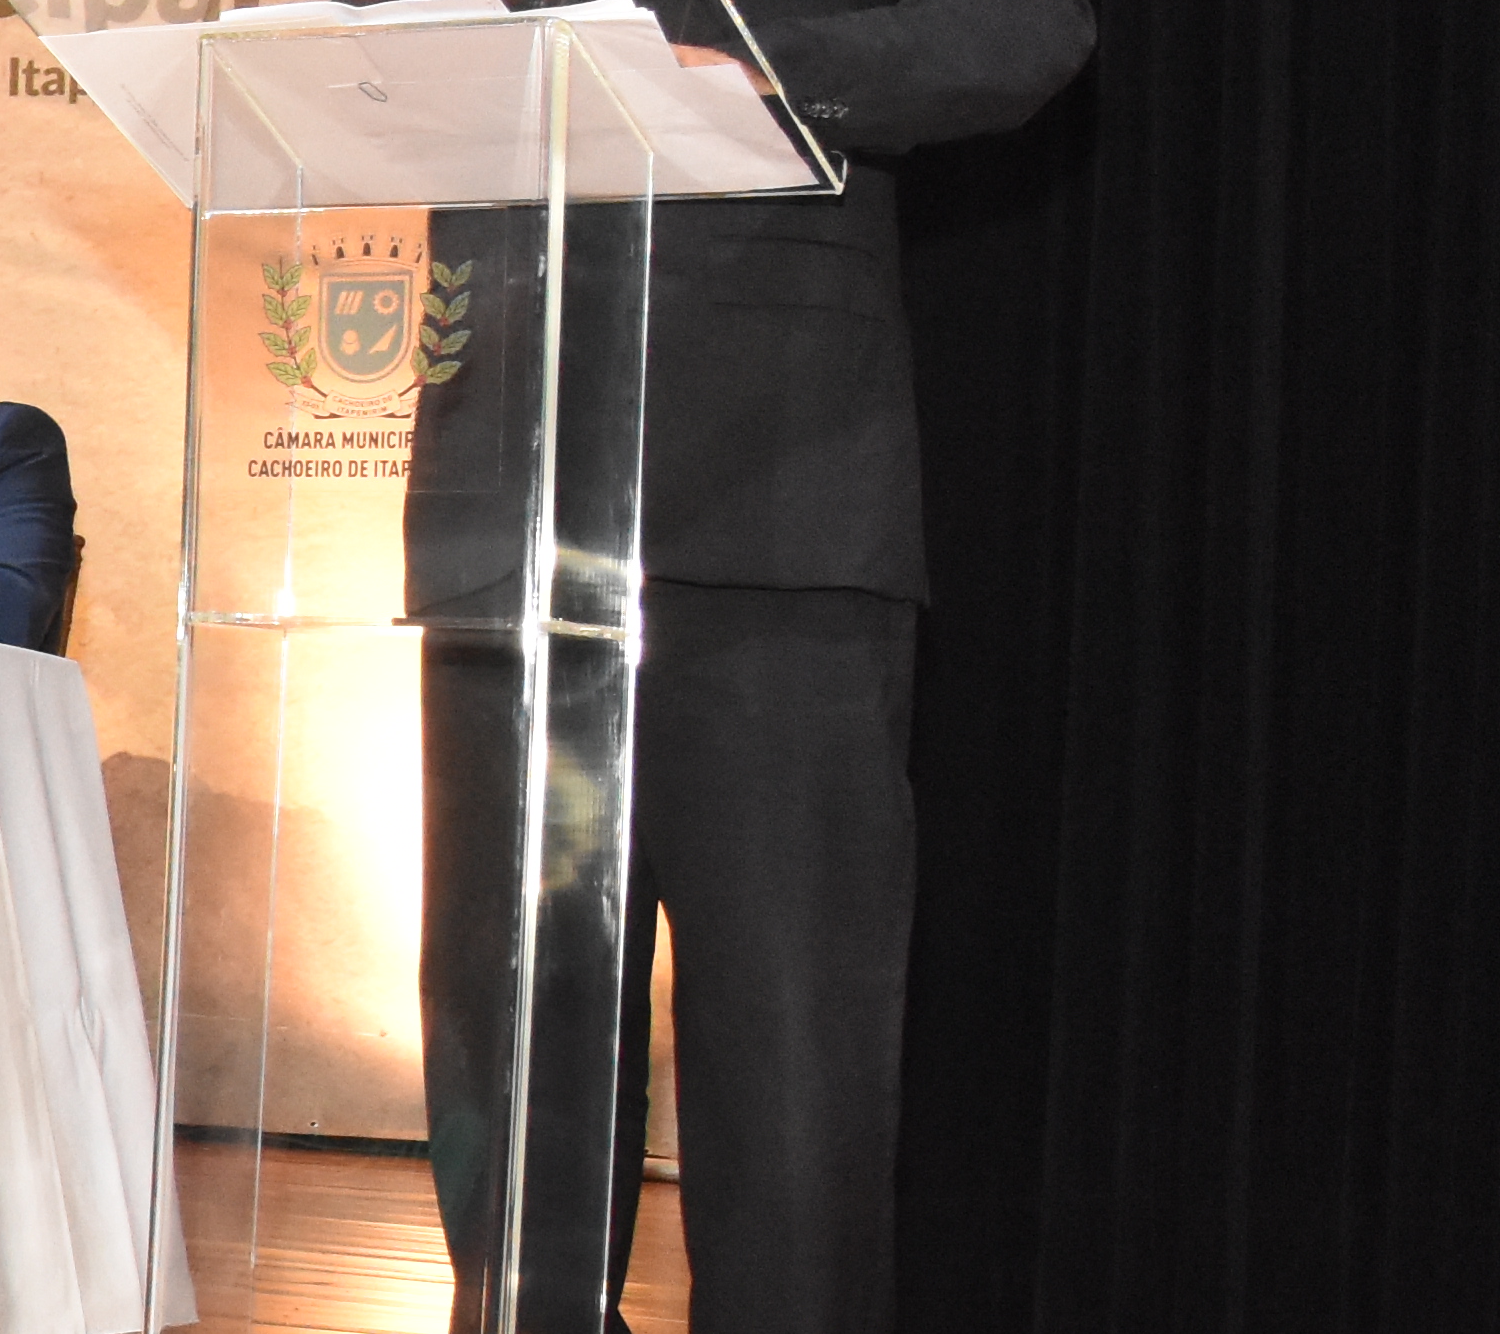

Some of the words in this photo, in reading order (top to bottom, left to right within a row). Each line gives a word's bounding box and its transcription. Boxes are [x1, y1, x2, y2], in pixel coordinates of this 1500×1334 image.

[263, 427, 336, 449] CÂMARA
[248, 460, 343, 478] CACHOEIRO
[348, 460, 369, 478] DE
